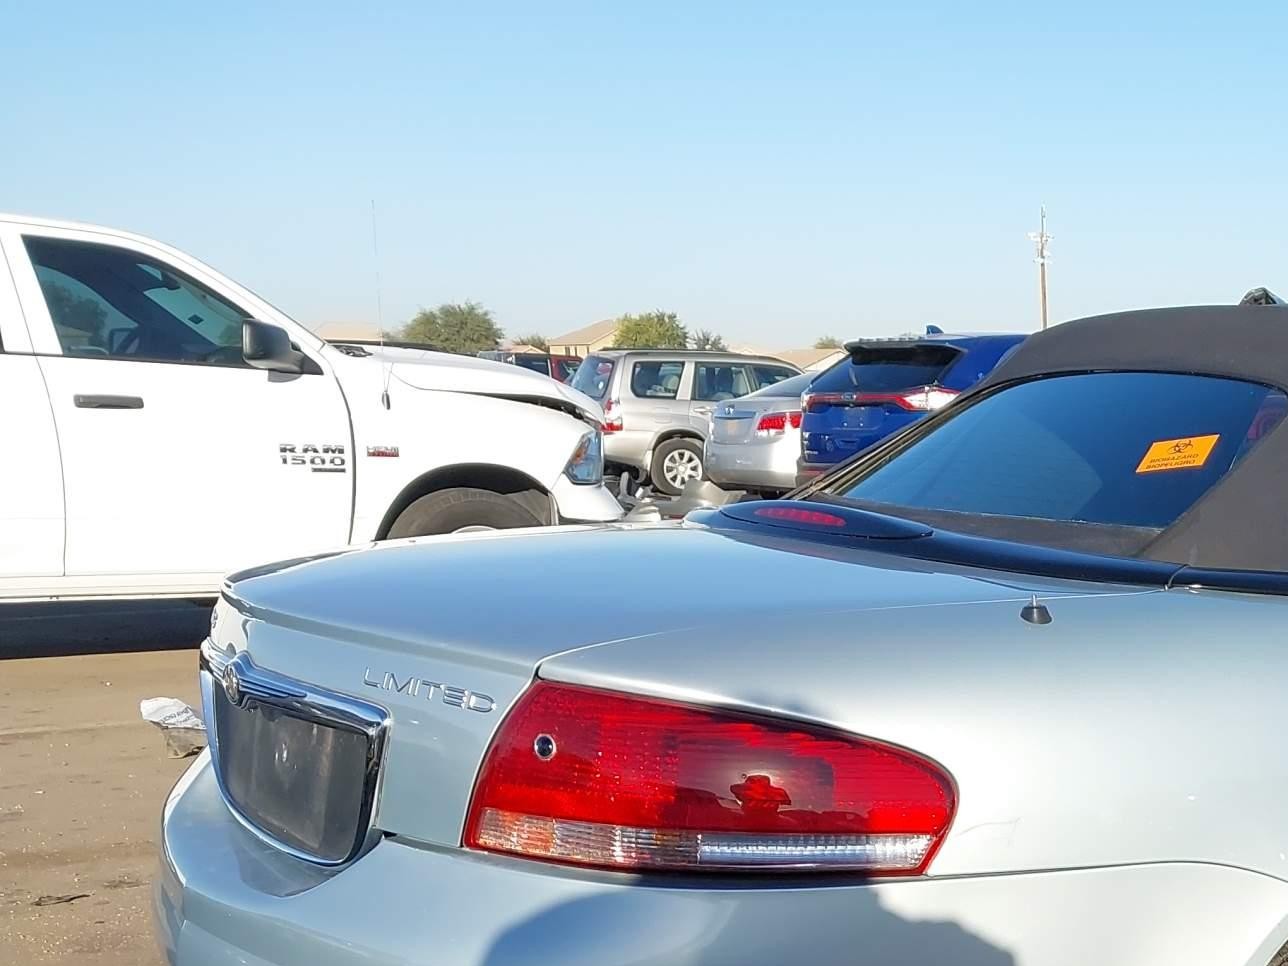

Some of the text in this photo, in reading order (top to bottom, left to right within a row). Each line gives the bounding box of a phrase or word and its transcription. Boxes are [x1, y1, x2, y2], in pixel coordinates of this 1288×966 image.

[279, 443, 345, 454] RAM
[279, 455, 345, 466] 1500
[363, 666, 497, 713] LIMITED
